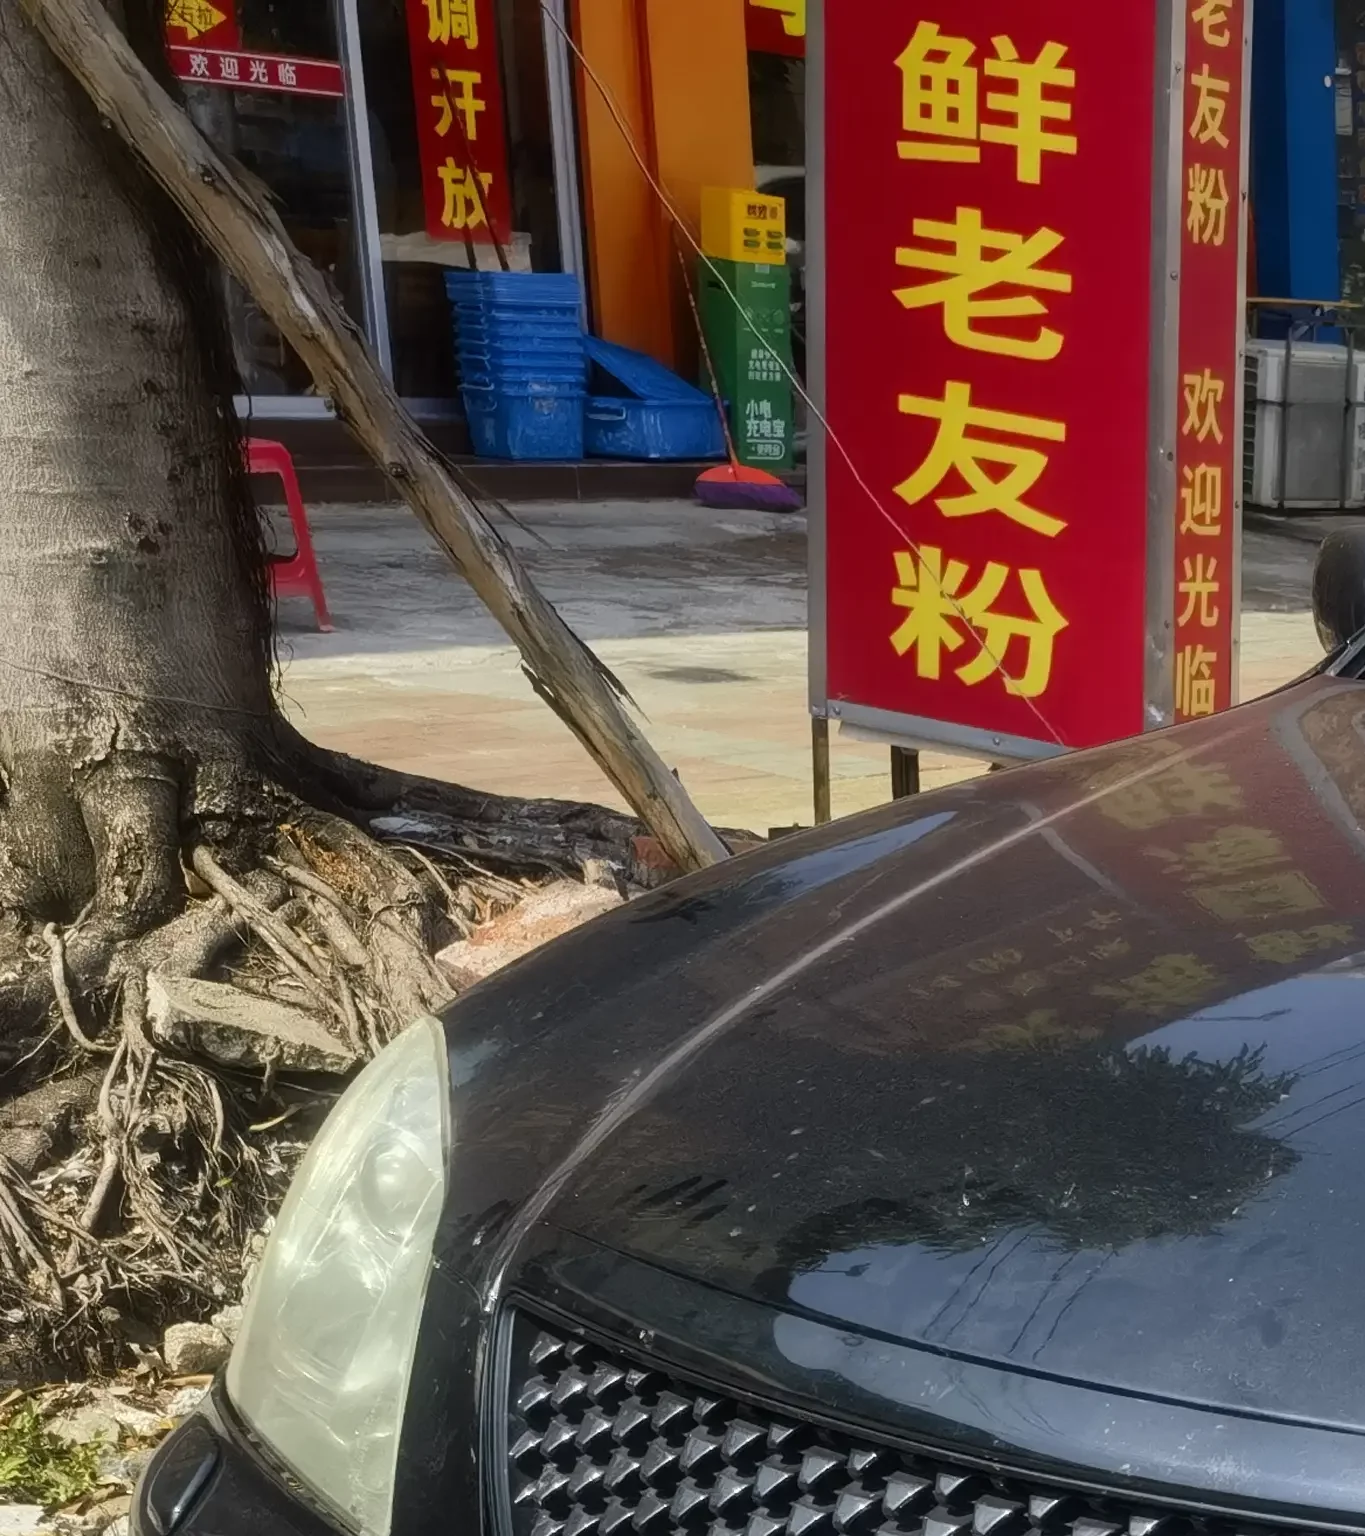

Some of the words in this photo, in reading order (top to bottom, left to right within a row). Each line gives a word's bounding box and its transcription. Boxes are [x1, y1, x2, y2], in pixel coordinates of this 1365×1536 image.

[189, 53, 297, 86] 欢迎光临
[745, 419, 786, 438] 充电宝
[889, 20, 1078, 698] 鲜老友粉
[1175, 368, 1225, 717] 欢迎光临
